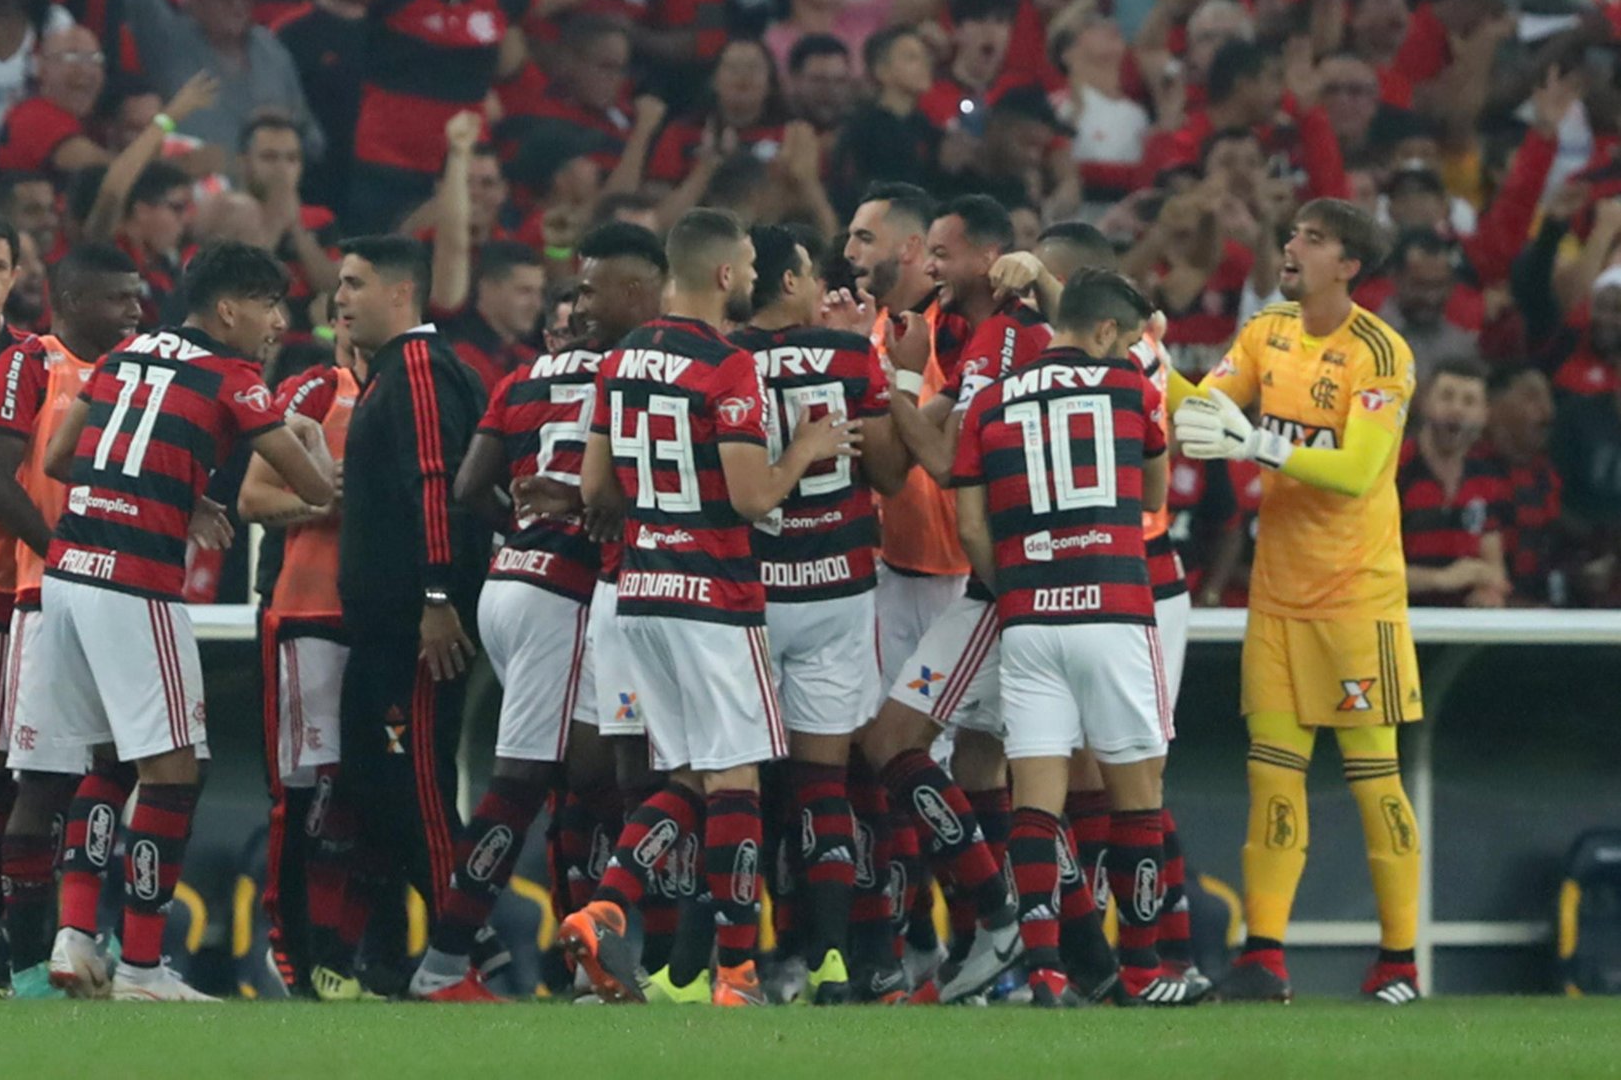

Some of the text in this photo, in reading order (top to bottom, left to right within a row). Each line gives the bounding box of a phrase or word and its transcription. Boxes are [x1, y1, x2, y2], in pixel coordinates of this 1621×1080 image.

[125, 331, 213, 361] MRV
[530, 350, 613, 379] MR
[0, 350, 25, 420] Carabao
[616, 349, 692, 384] MRV
[1002, 363, 1110, 404] MRV
[536, 382, 597, 486] 2
[609, 390, 702, 513] 43
[1003, 393, 1118, 515] 10
[1026, 530, 1112, 553] descomplica
[1033, 584, 1101, 612] DIEGO
